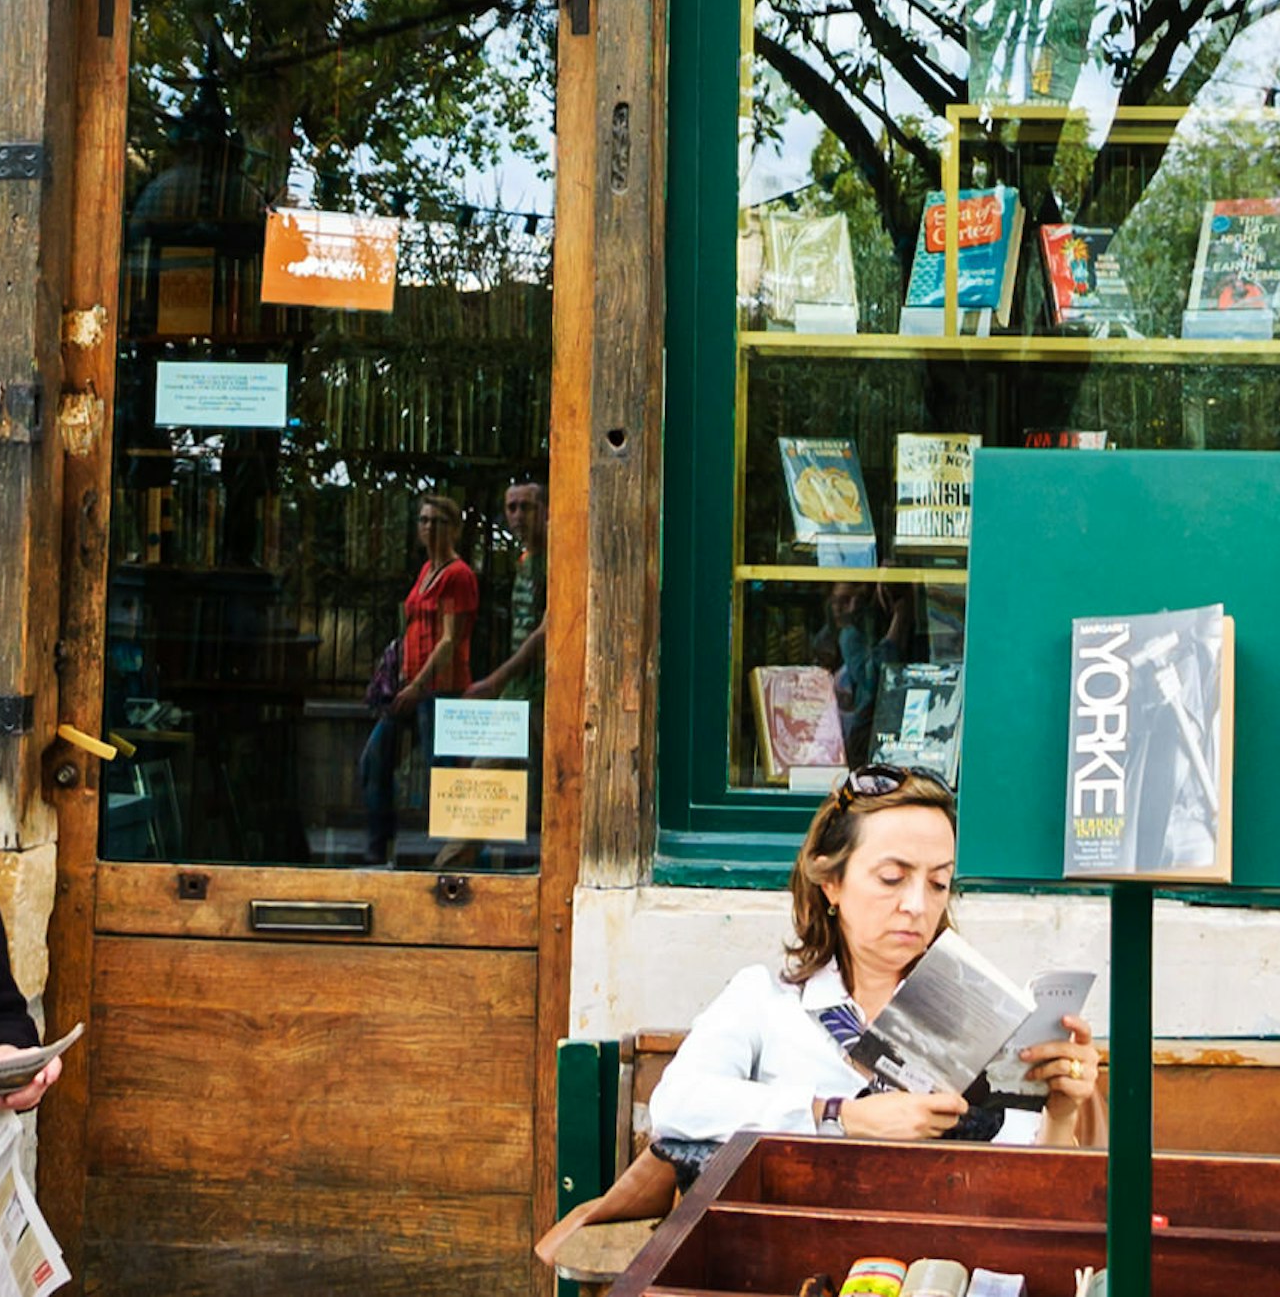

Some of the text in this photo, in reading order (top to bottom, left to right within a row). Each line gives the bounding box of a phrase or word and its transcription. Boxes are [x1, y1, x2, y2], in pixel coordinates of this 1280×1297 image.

[933, 206, 971, 226] Sa
[932, 223, 995, 246] Crtez
[1073, 631, 1131, 816] YORKE
